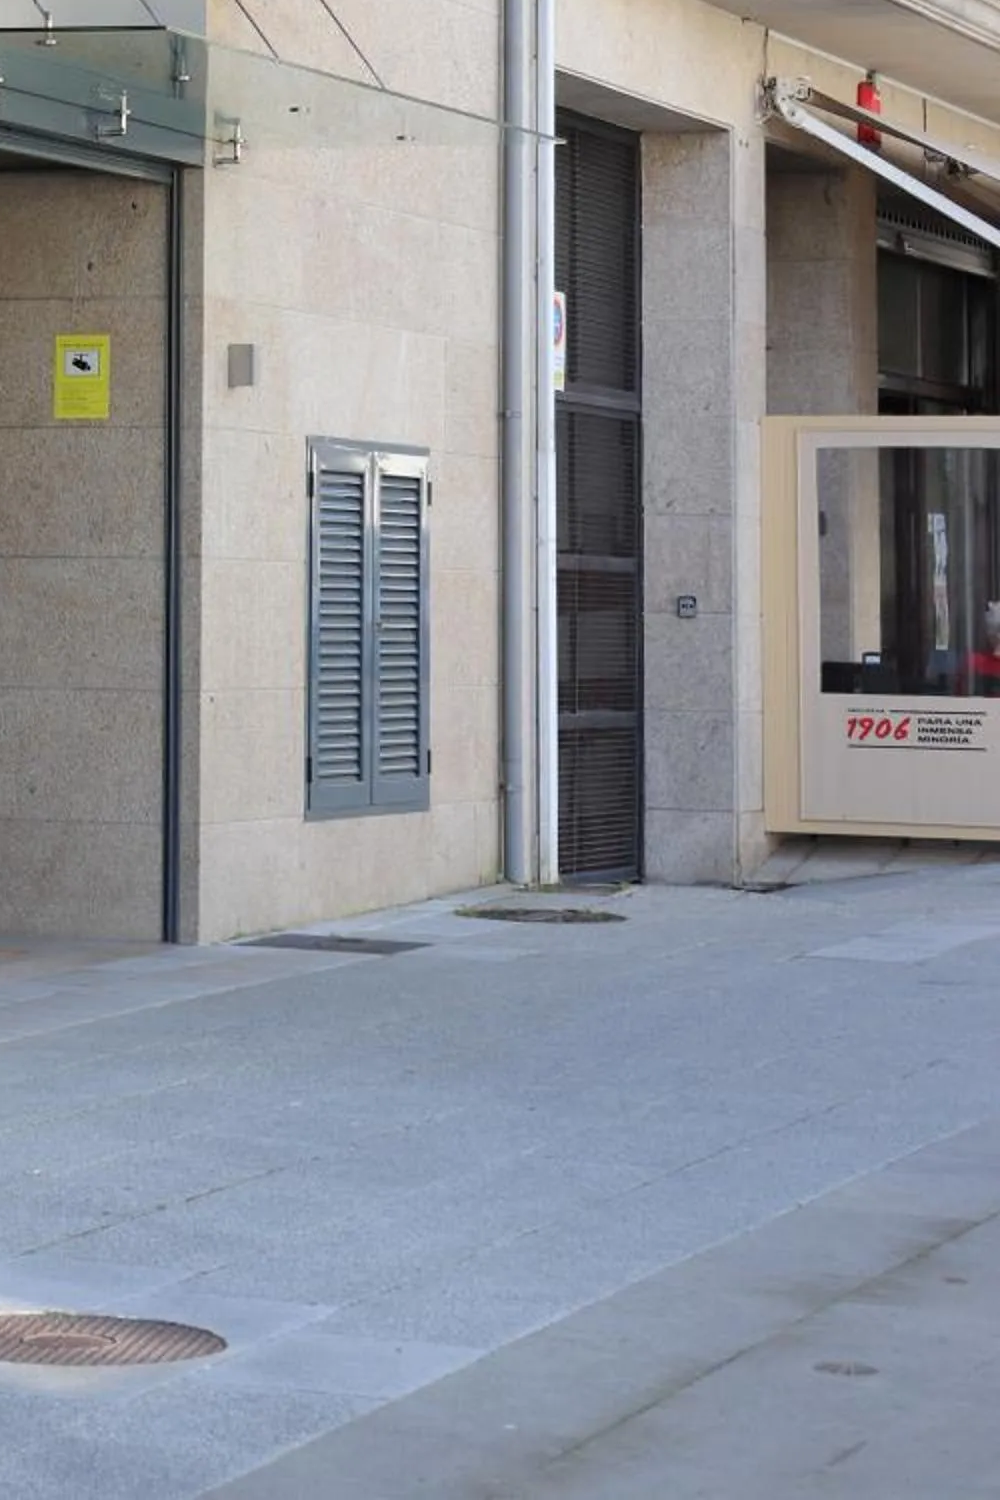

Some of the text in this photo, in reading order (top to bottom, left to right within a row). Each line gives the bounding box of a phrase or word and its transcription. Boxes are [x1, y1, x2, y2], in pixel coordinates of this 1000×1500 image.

[847, 716, 911, 740] 1906
[917, 717, 982, 727] PARA UNA
